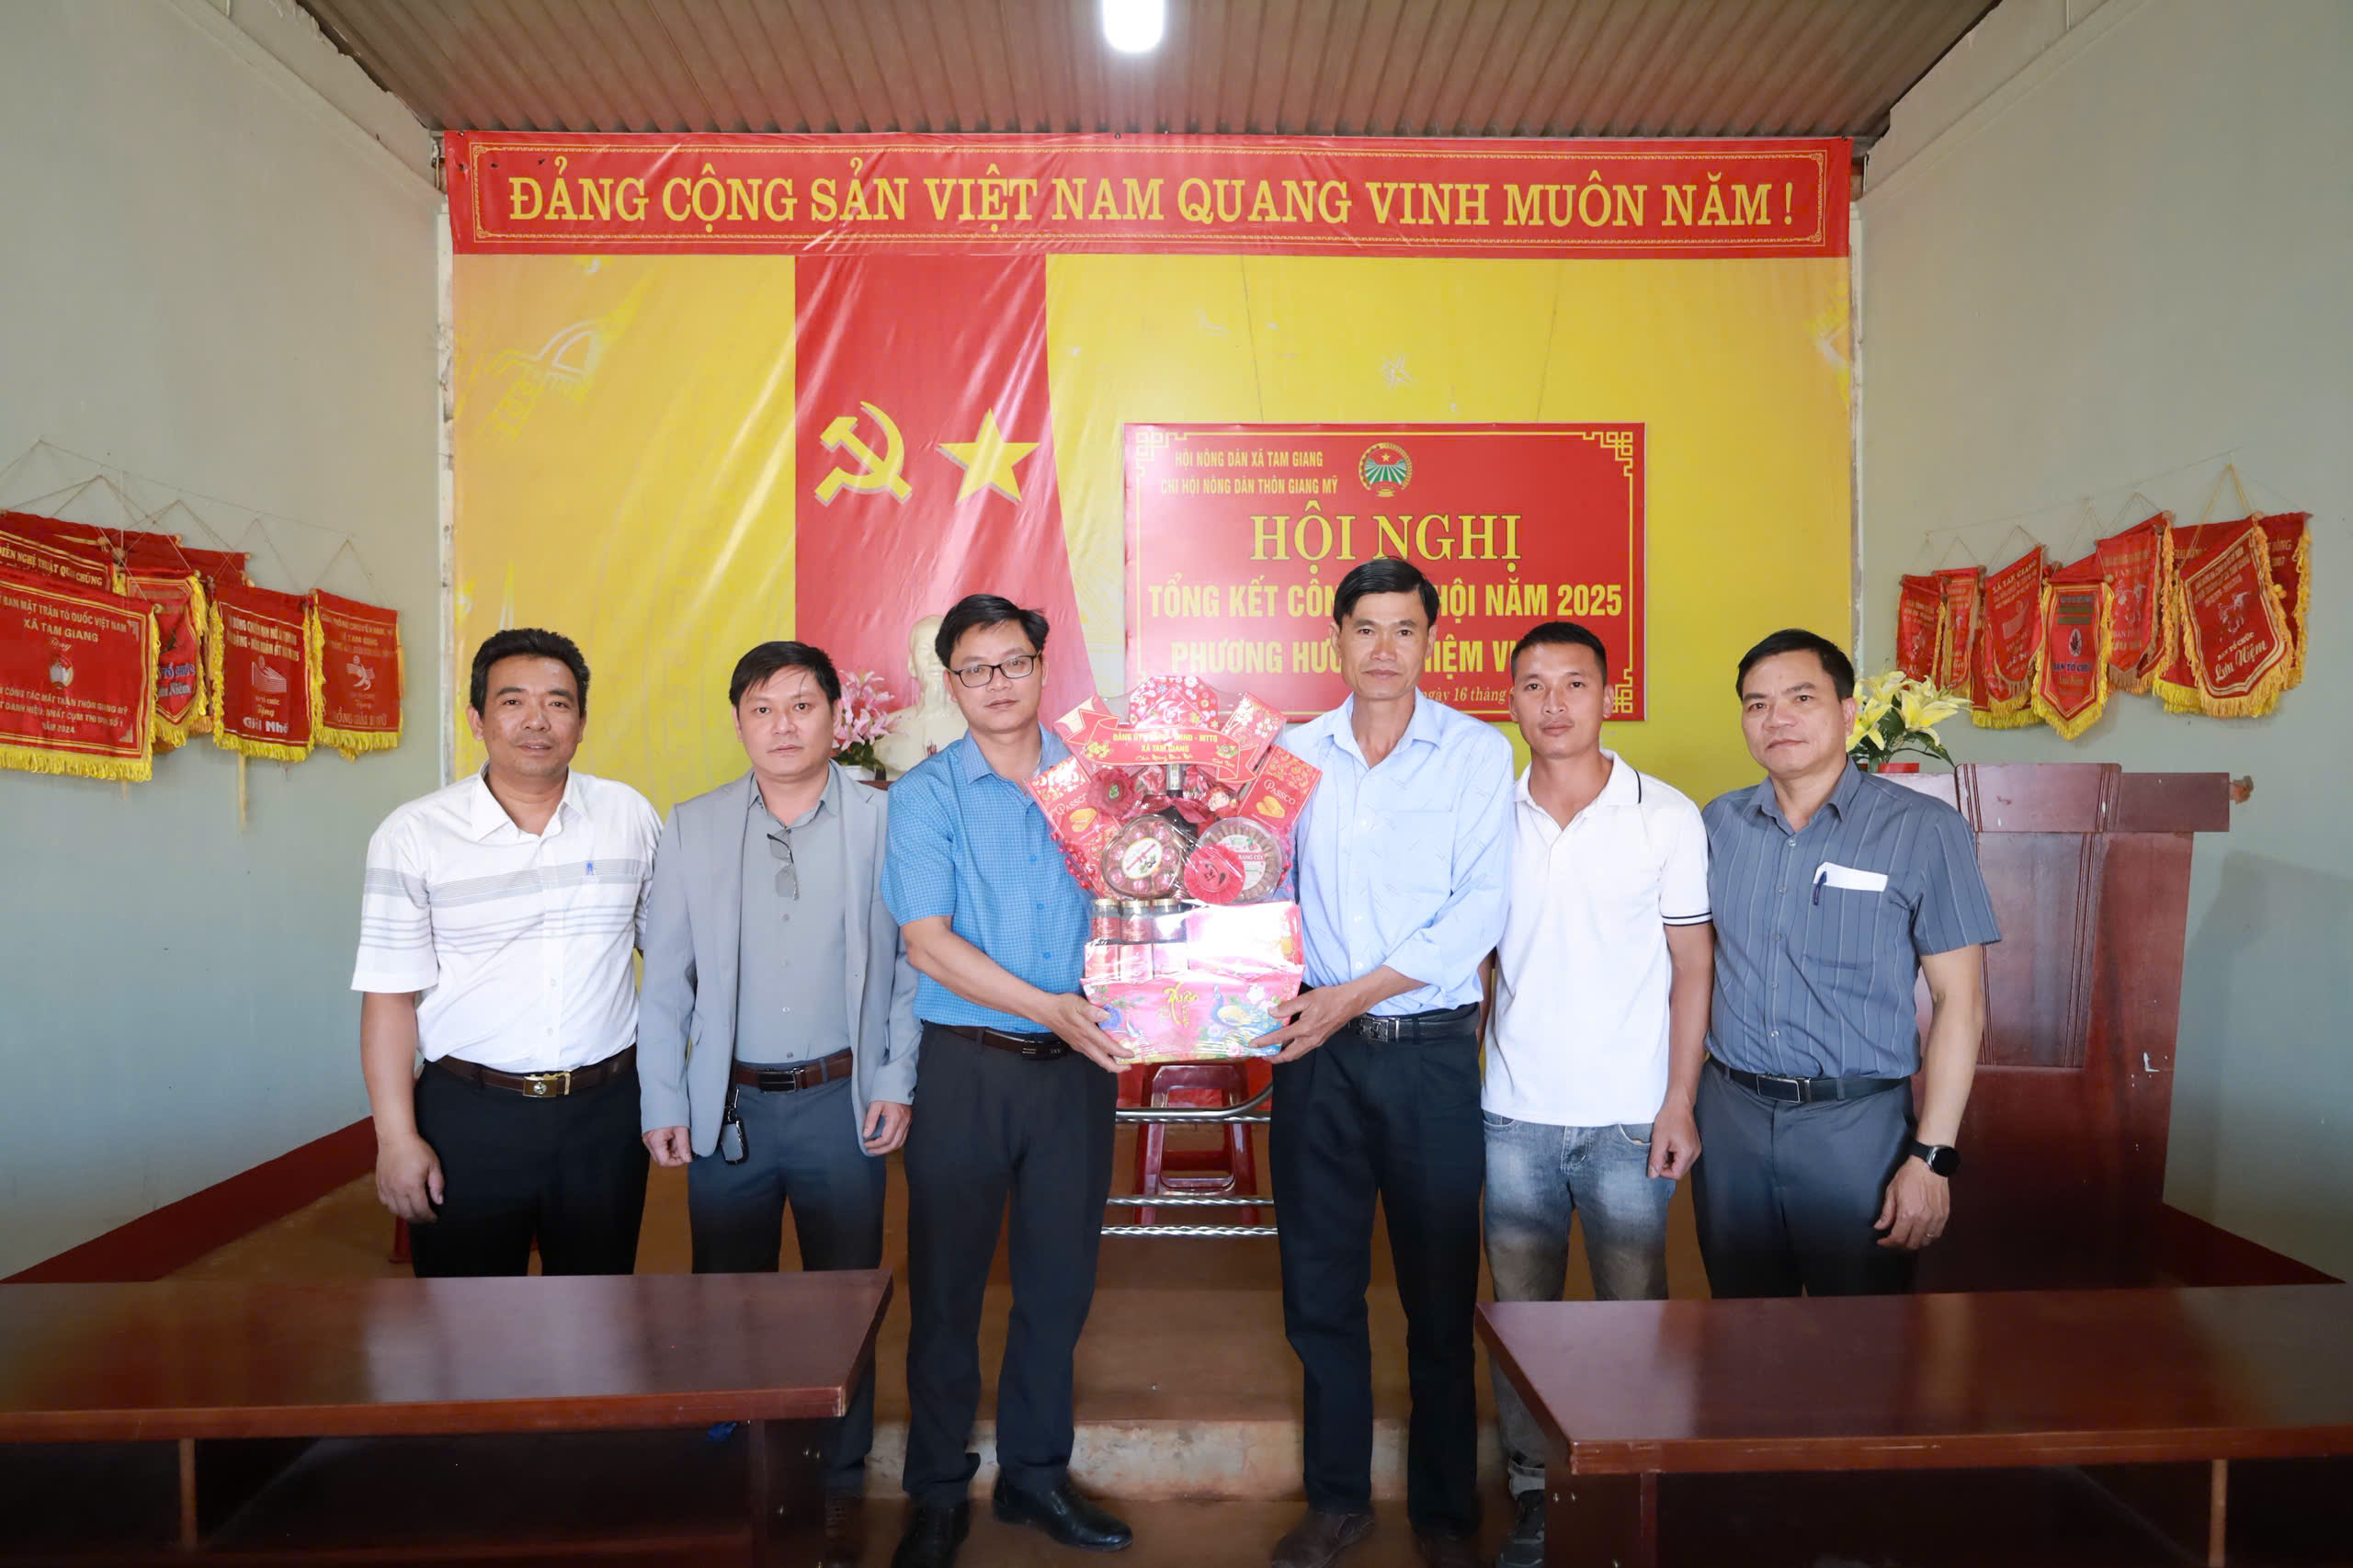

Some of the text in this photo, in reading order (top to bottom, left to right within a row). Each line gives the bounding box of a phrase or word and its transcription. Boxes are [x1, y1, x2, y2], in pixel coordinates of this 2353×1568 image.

[509, 156, 648, 222] ĐẢNG
[662, 163, 797, 233] CỘNG
[811, 157, 906, 222] SẢN
[924, 163, 1038, 233] VIỆT
[1051, 177, 1164, 222] NAM
[1177, 177, 1352, 225] QUANG
[1366, 182, 1489, 226] VINH
[1504, 170, 1645, 227] MUÔN
[1661, 173, 1771, 227] NĂM
[1176, 449, 1324, 470] HỘI NÔNG DÂN XÃ TAM GIANG
[1182, 476, 1199, 496] HỘI
[1203, 475, 1231, 494] NÔNG
[1234, 475, 1255, 494] DÂN
[1258, 474, 1285, 494] THÔN
[1289, 478, 1320, 494] GIANG
[1322, 474, 1338, 494] MỸ
[1250, 499, 1522, 574] HỘI NGHỊ
[1148, 572, 1622, 623] TỔNG KẾT CÔN HỘI NĂM 2025
[41, 622, 62, 635] TAM
[64, 628, 99, 642] GIANG
[1171, 638, 1284, 674] PHƯƠNG
[1425, 633, 1483, 680] IỆM
[1453, 686, 1469, 702] 16
[1471, 686, 1507, 705] tháng
[1263, 778, 1296, 805] PASSCO
